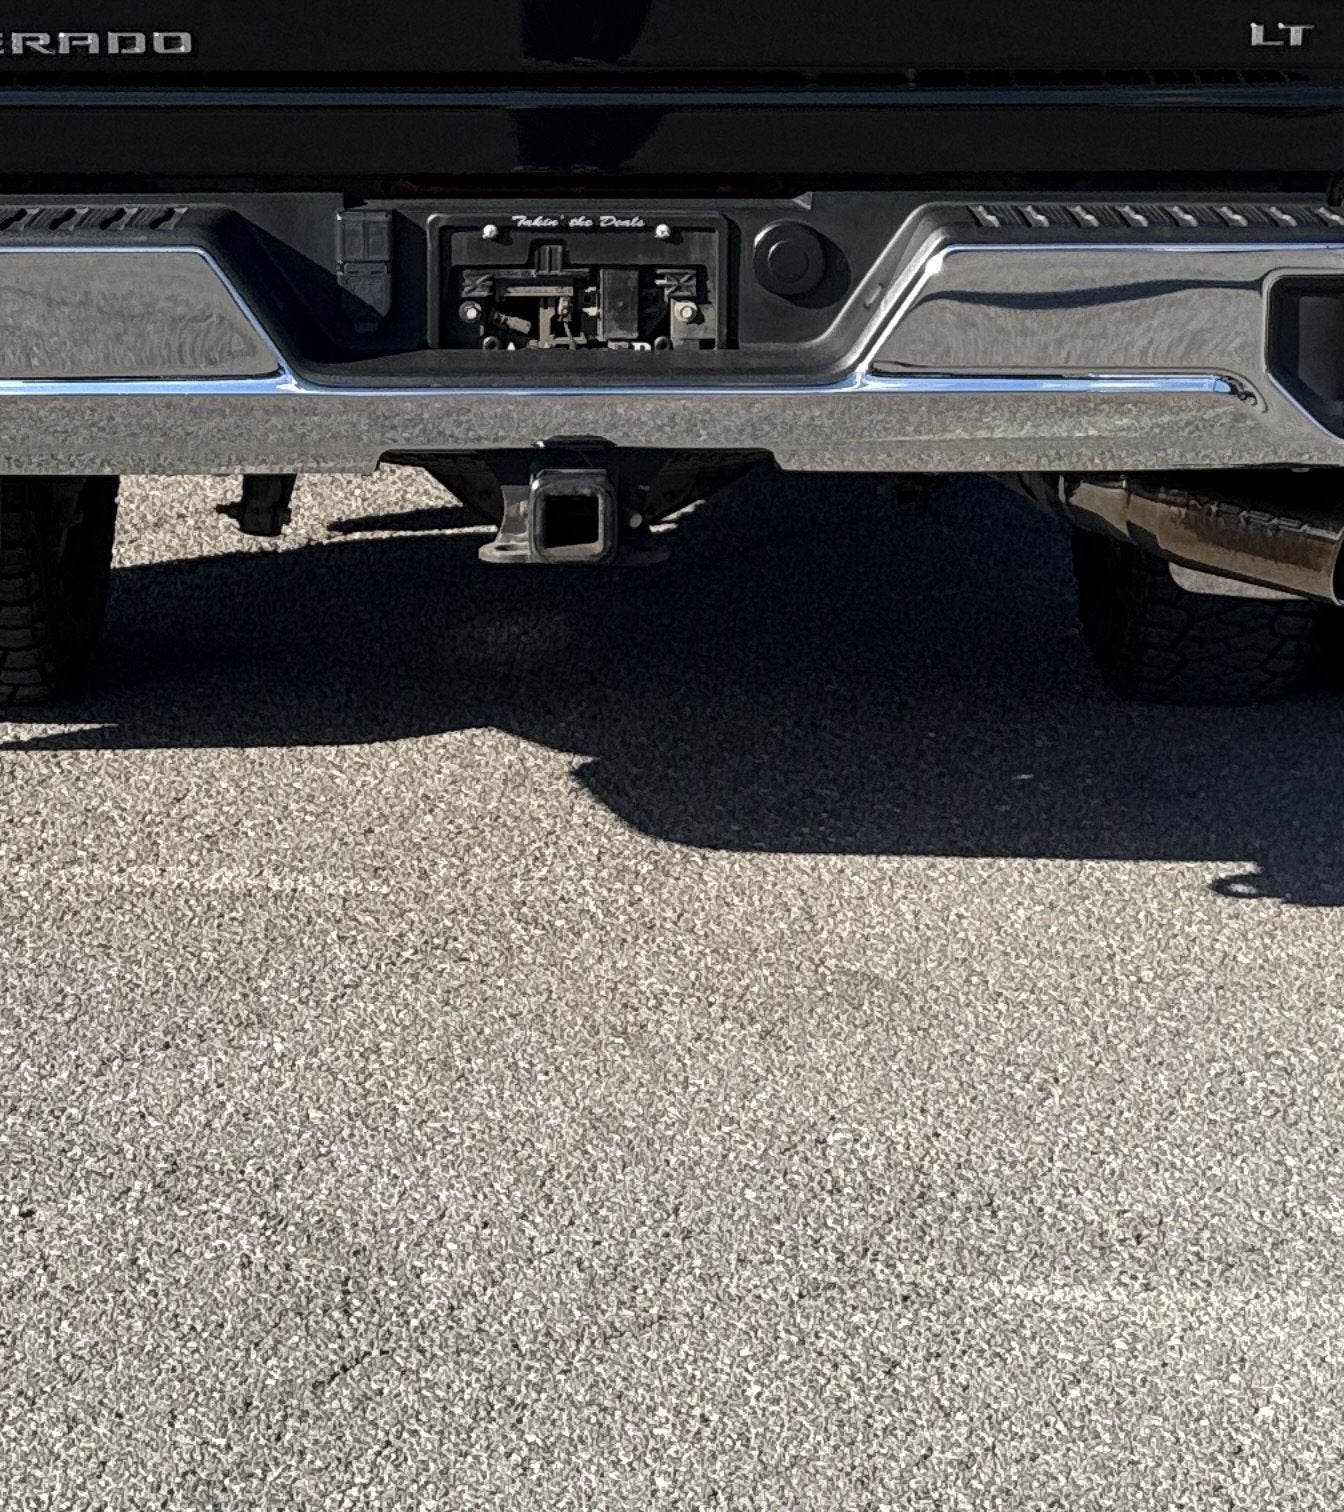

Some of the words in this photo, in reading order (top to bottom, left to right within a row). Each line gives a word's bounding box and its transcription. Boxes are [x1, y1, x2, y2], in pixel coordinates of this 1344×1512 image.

[1250, 22, 1315, 46] LT
[511, 214, 565, 227] Takin'
[568, 215, 593, 227] the
[599, 215, 645, 227] Deals
